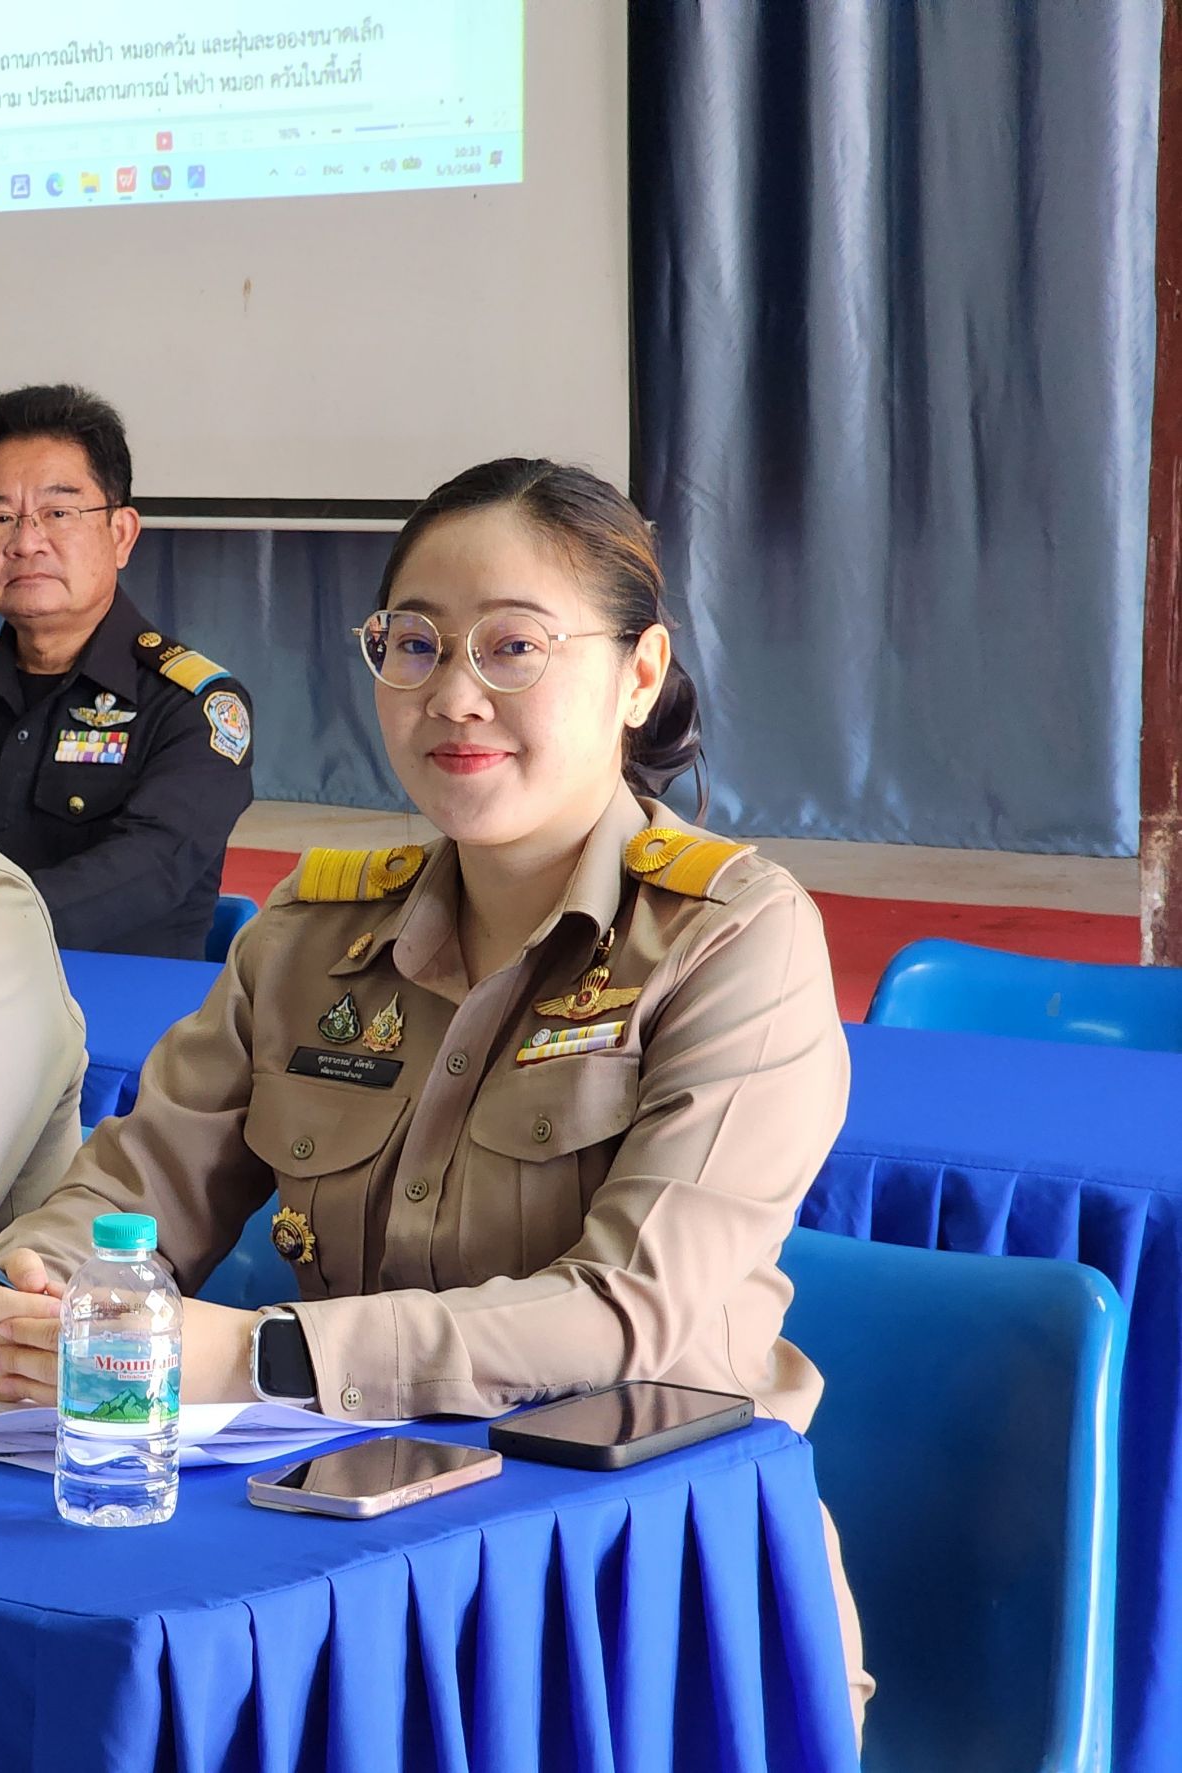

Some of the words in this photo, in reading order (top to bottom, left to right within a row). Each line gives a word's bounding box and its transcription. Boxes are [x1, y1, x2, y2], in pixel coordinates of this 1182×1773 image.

[121, 33, 196, 60] หมอกควัน
[173, 71, 214, 95] ไฟป่า
[220, 72, 264, 92] หมอก
[270, 53, 363, 88] ควันในพื้นที่
[322, 163, 344, 176] ENG
